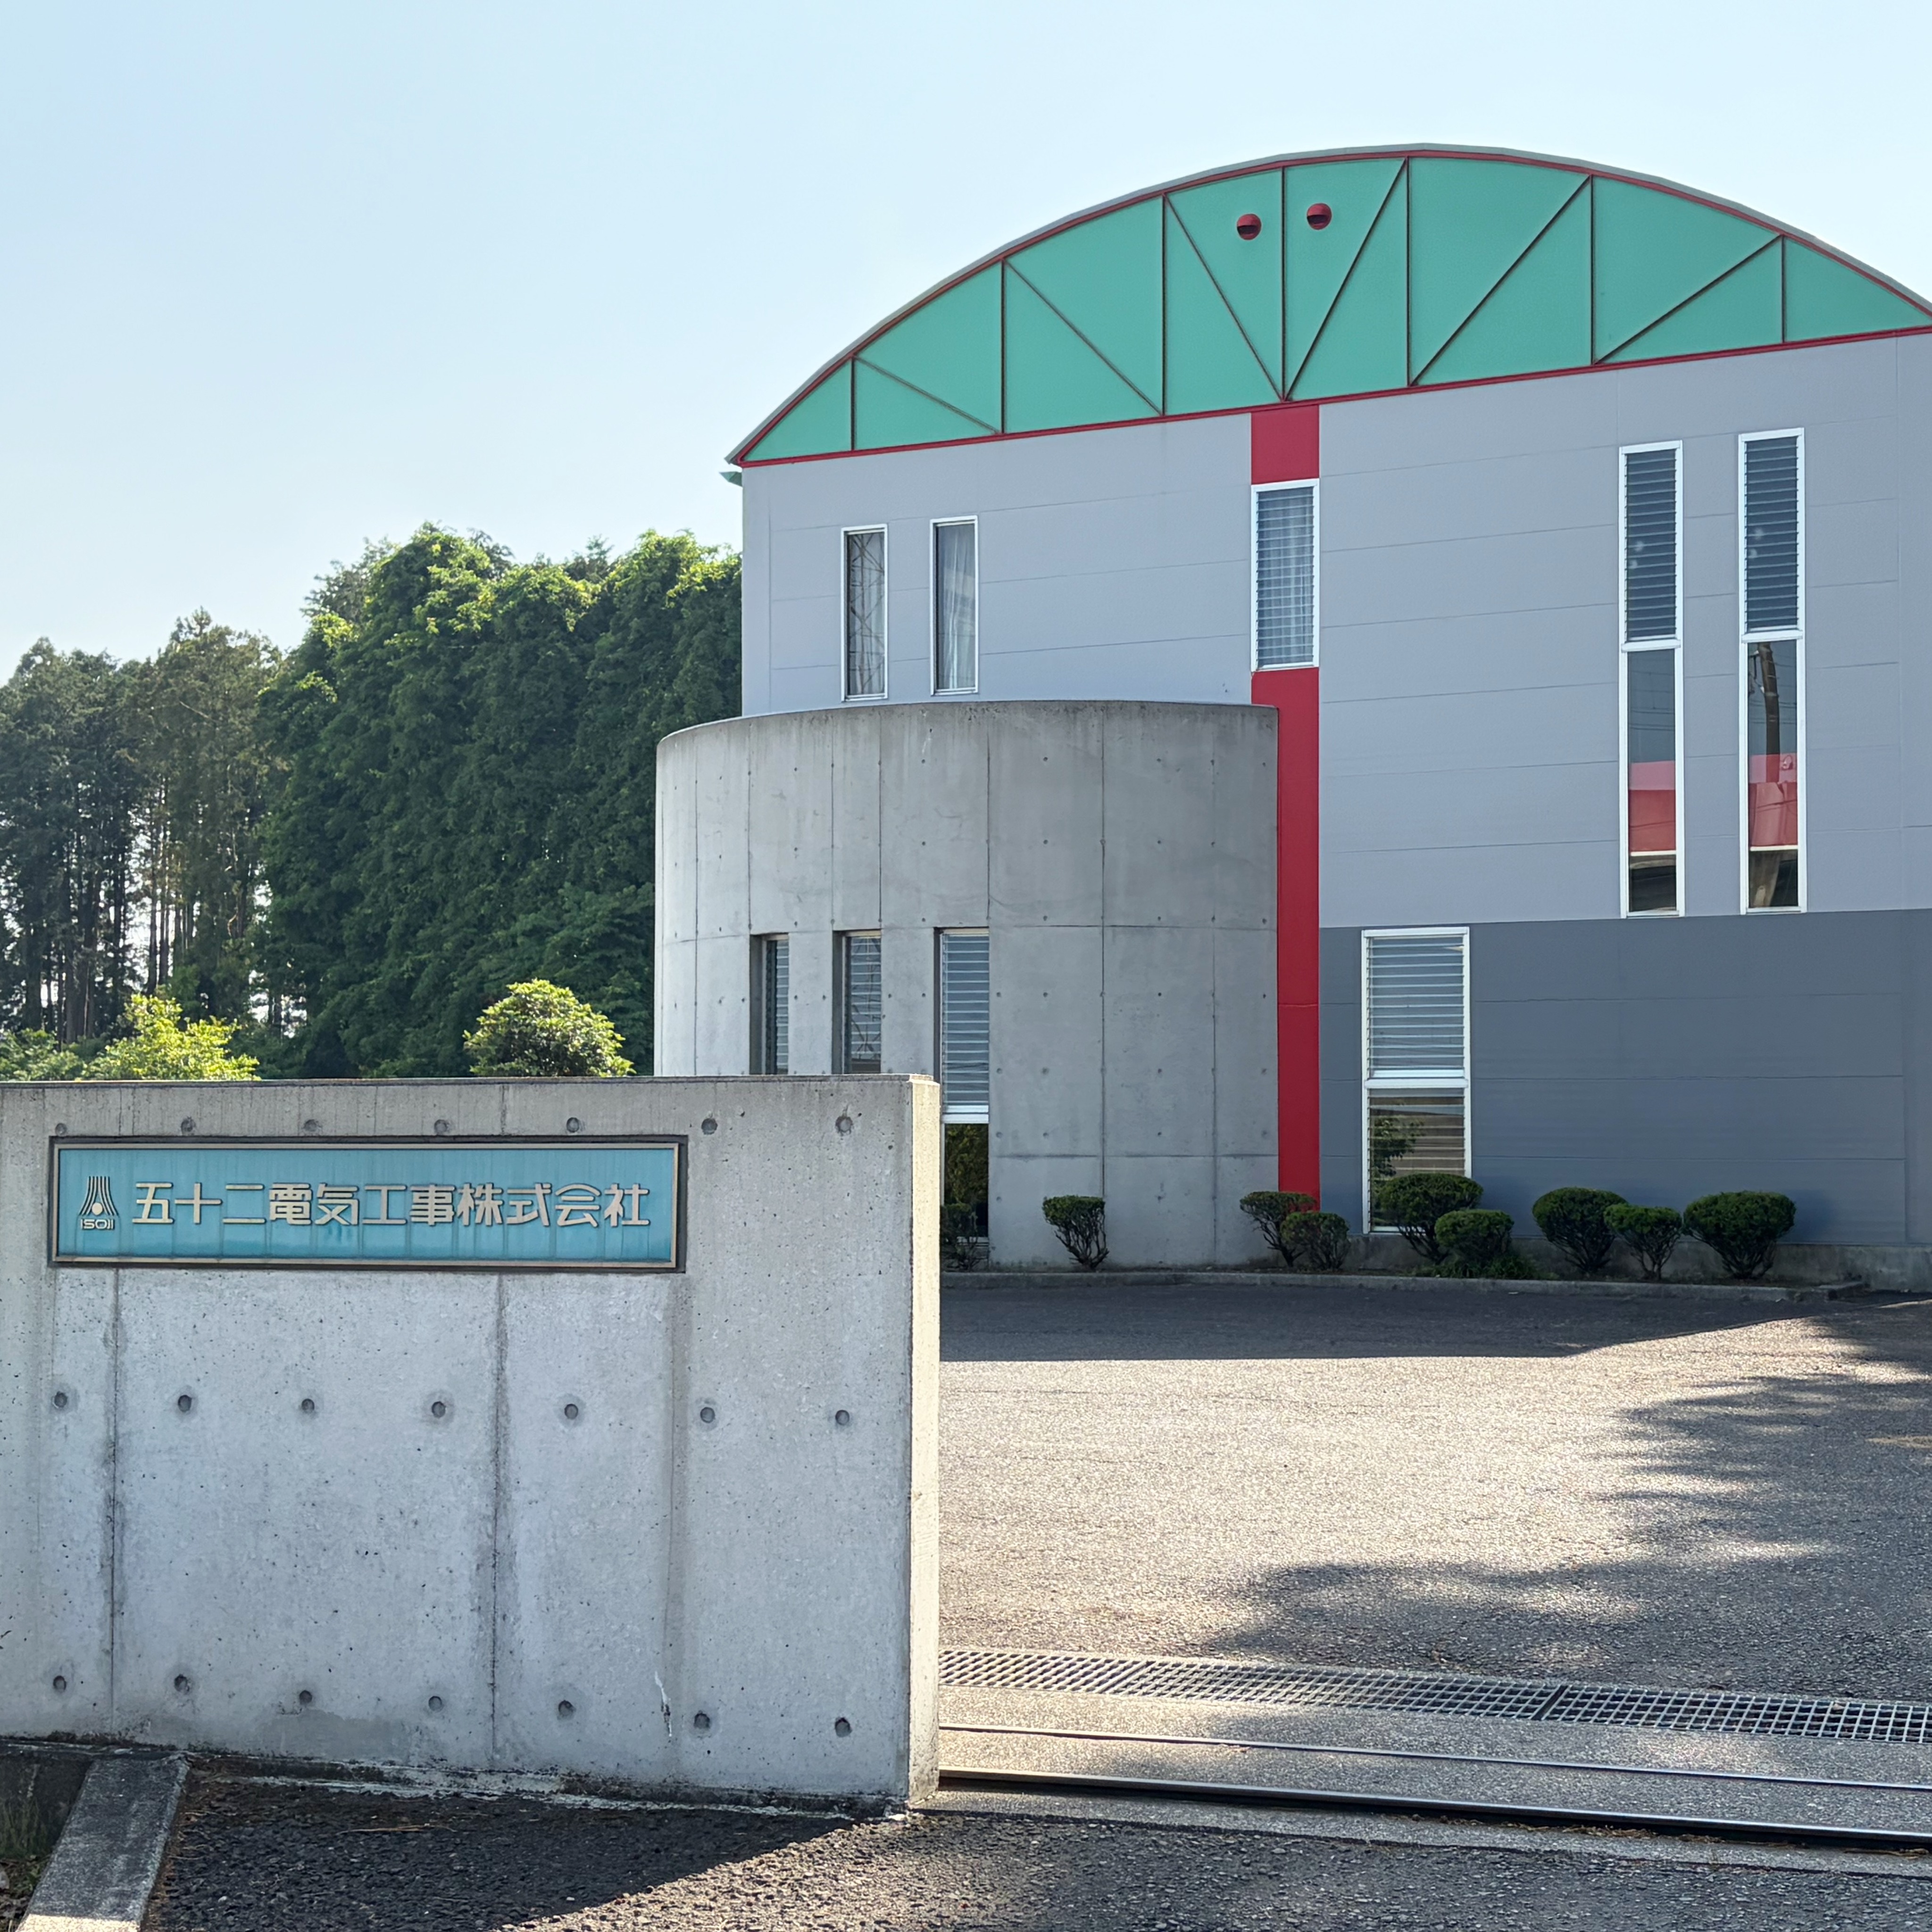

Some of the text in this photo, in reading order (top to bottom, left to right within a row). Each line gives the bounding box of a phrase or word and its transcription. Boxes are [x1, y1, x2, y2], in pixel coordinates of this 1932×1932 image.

[132, 1182, 650, 1227] 五十二電気工事株式会社
